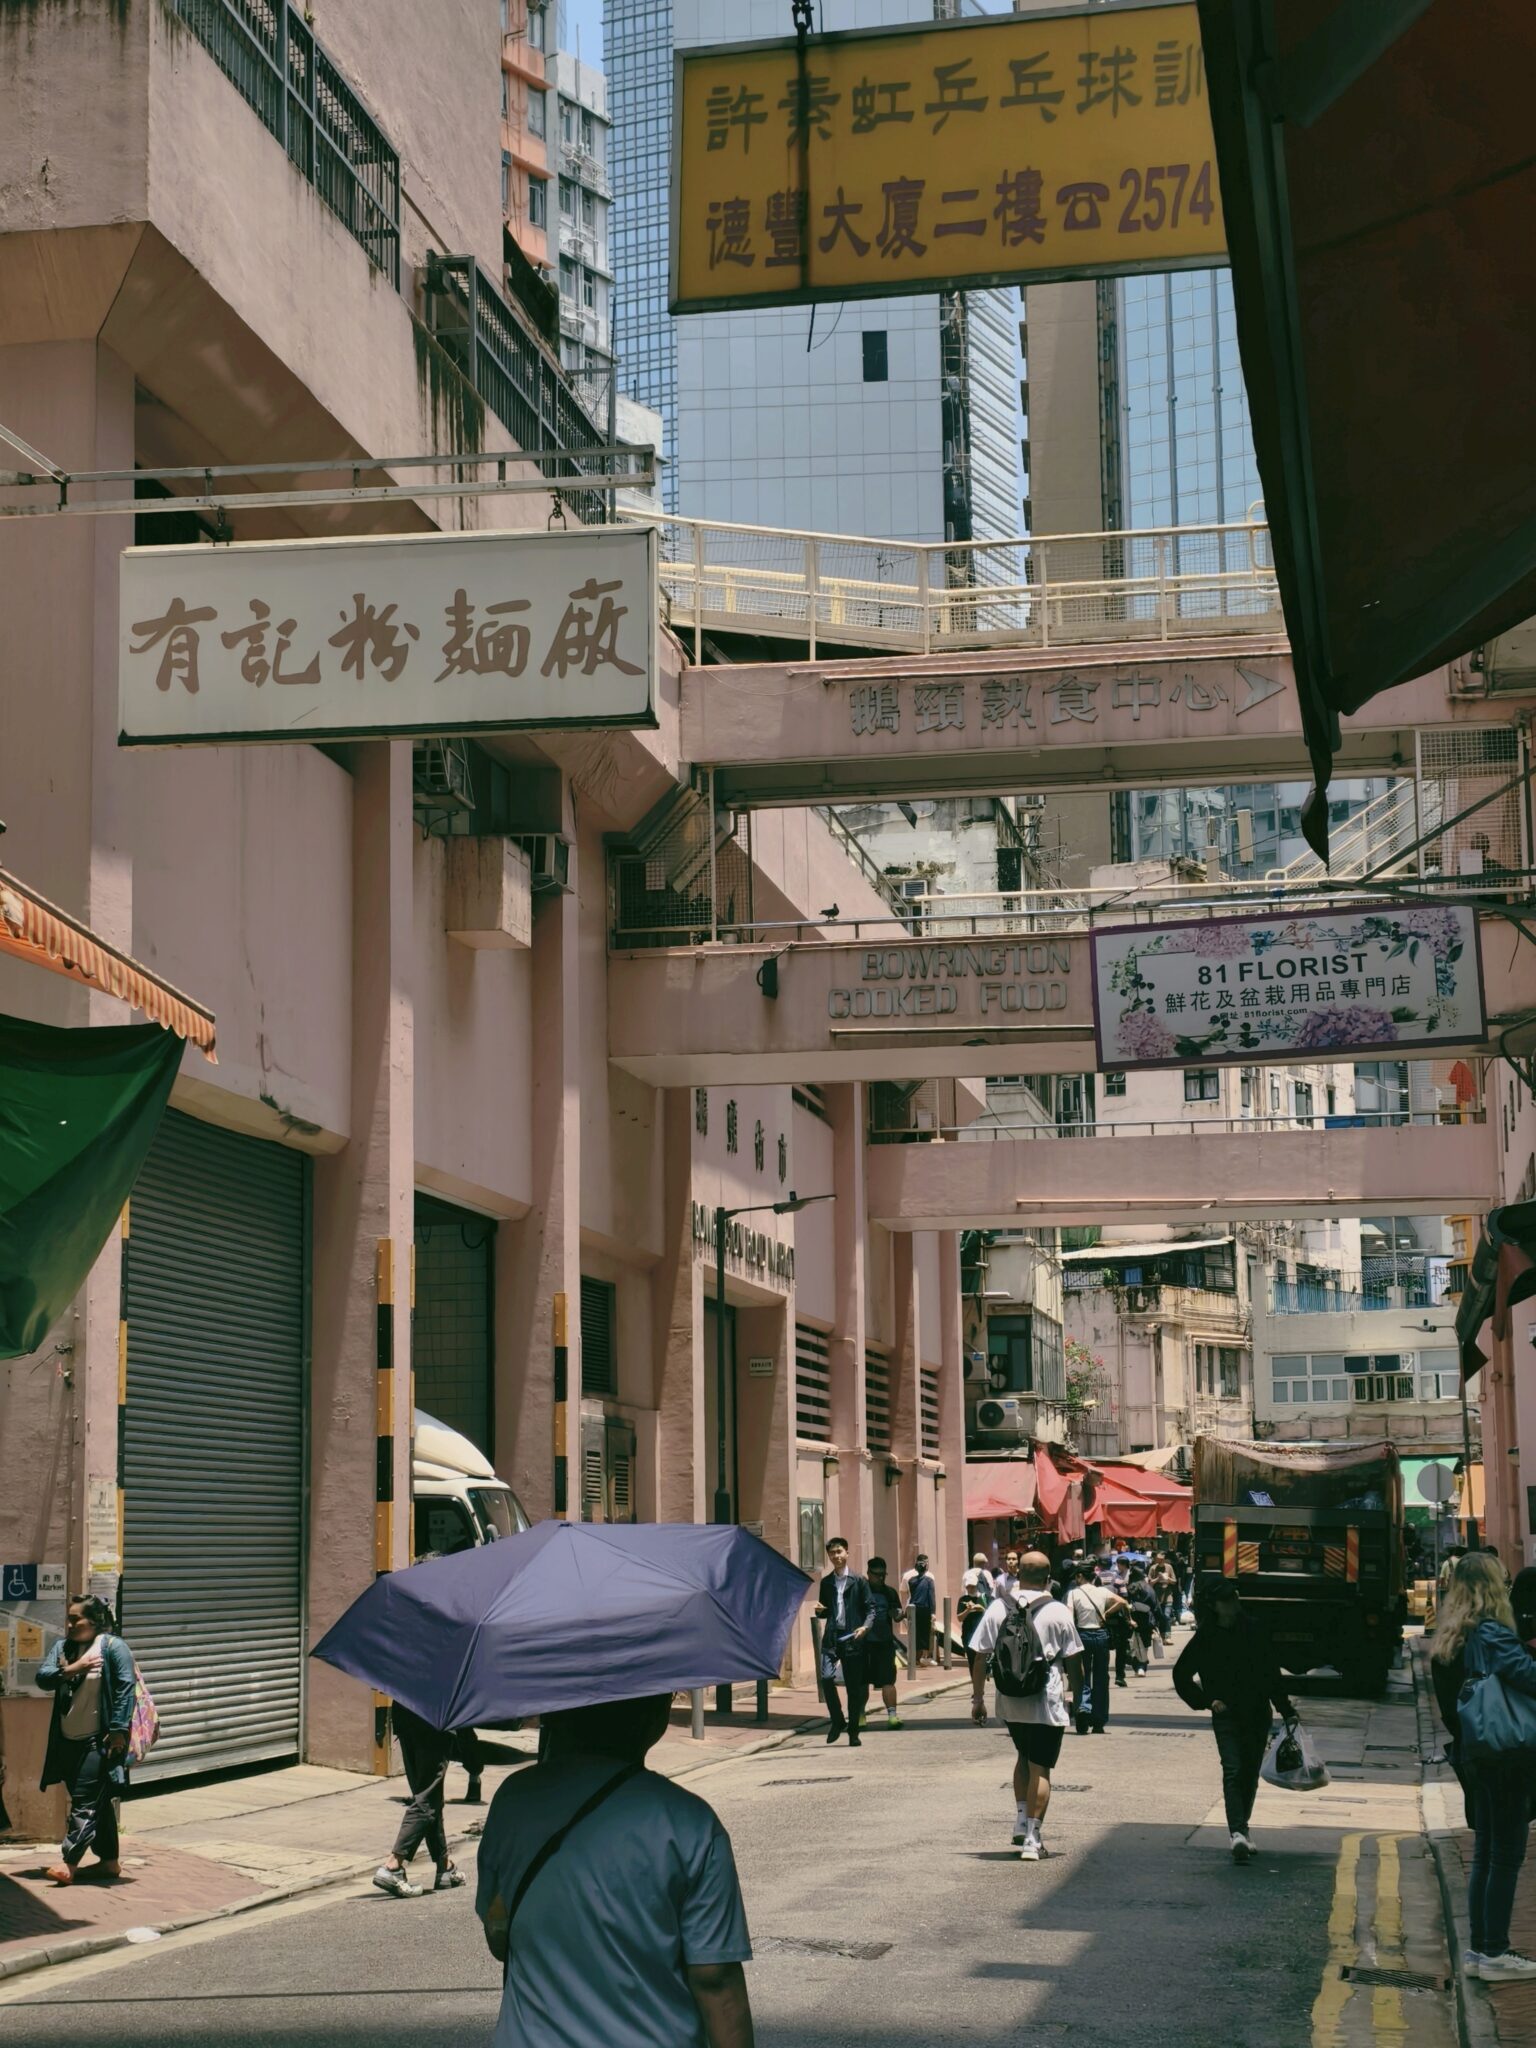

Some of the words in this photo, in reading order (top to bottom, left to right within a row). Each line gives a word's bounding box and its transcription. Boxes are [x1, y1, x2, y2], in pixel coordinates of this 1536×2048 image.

[1118, 160, 1214, 234] 2574
[129, 578, 647, 694] 有記粉麵廠
[850, 671, 1229, 735] 鵝頸熟食中心
[862, 943, 1070, 980] BOWRINGTON
[1197, 964, 1227, 985] 81
[1239, 953, 1368, 982] FLORIST
[828, 983, 957, 1018] COOKED
[980, 980, 1067, 1014] FOOD
[1165, 975, 1411, 1014] 鮮花及盆栽用品專門店
[38, 1583, 65, 1591] Market
